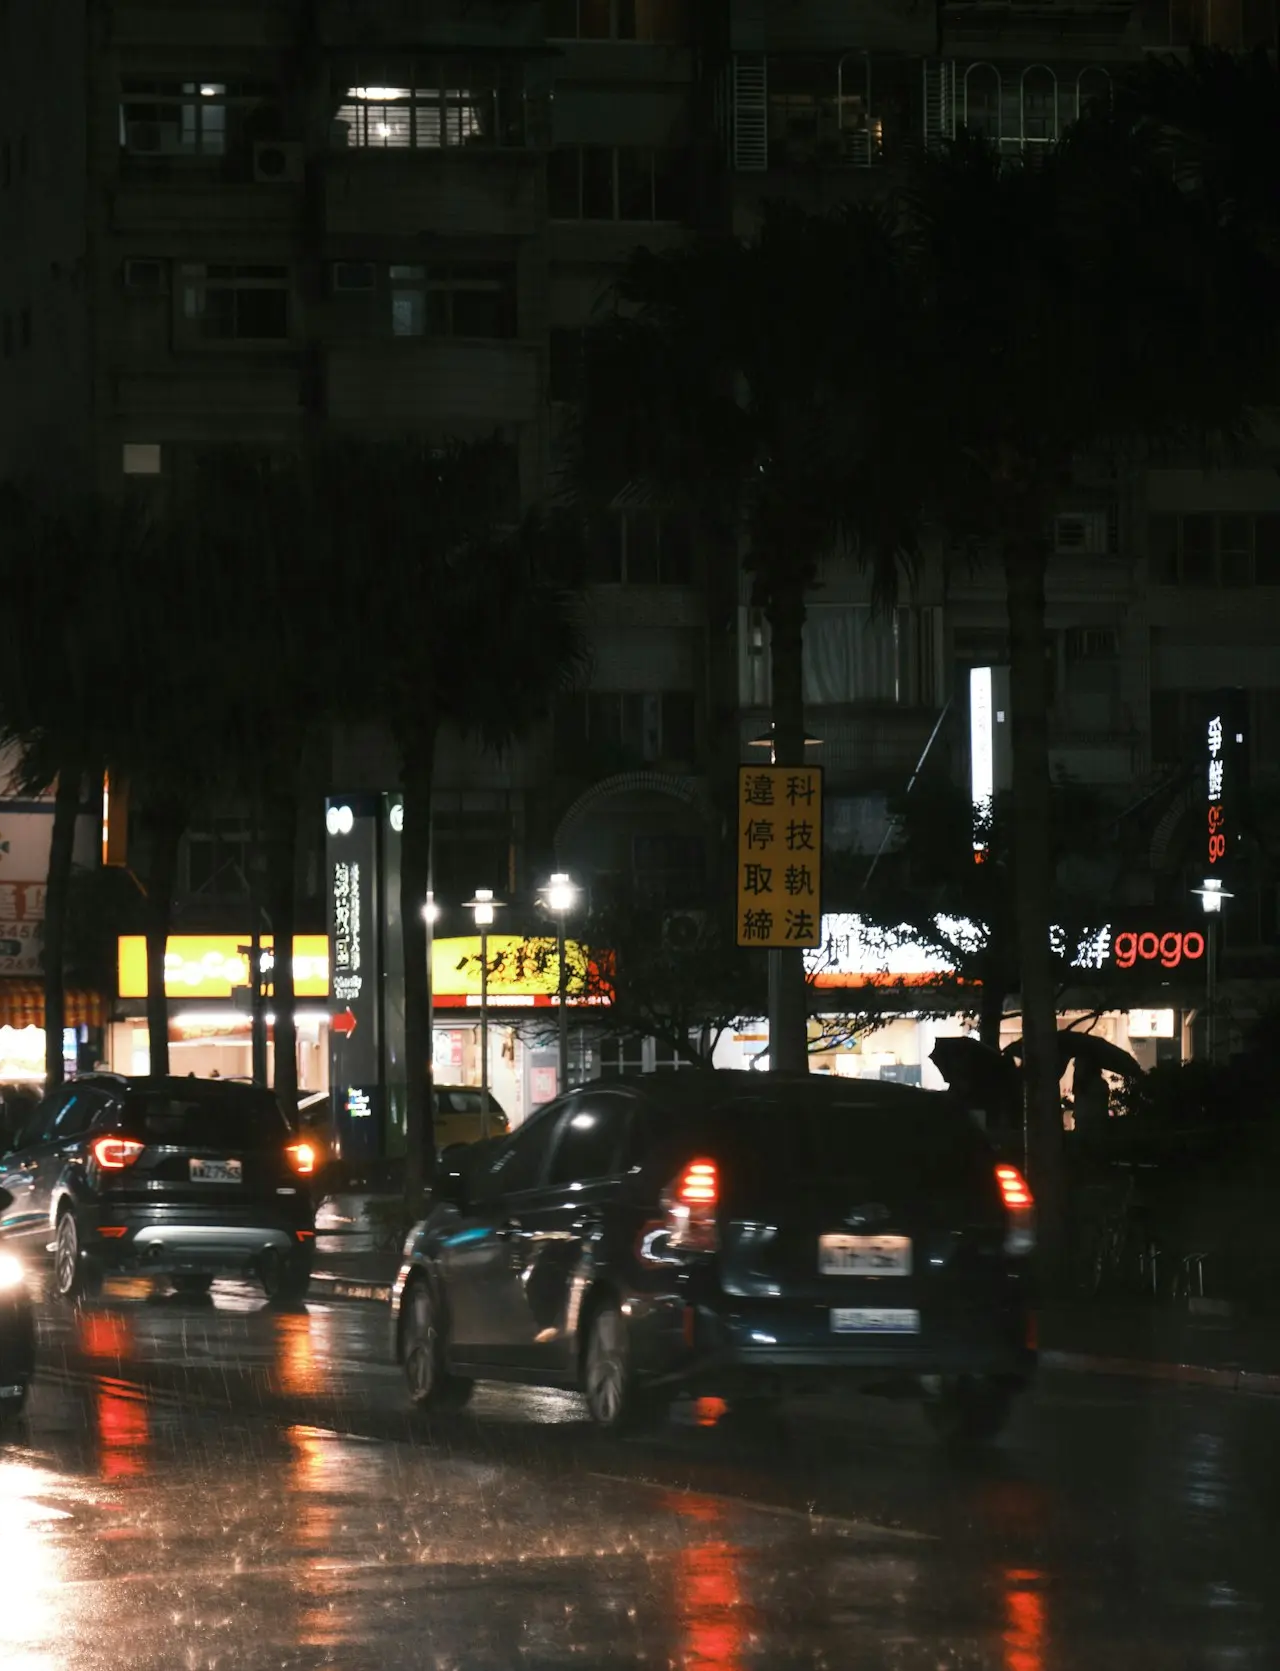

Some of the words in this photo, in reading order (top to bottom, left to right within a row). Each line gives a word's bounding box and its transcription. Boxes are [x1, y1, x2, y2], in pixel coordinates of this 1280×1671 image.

[743, 773, 775, 941] 違停取締
[784, 775, 816, 941] 科技執法
[1208, 833, 1225, 863] go
[1114, 931, 1205, 968] gogo
